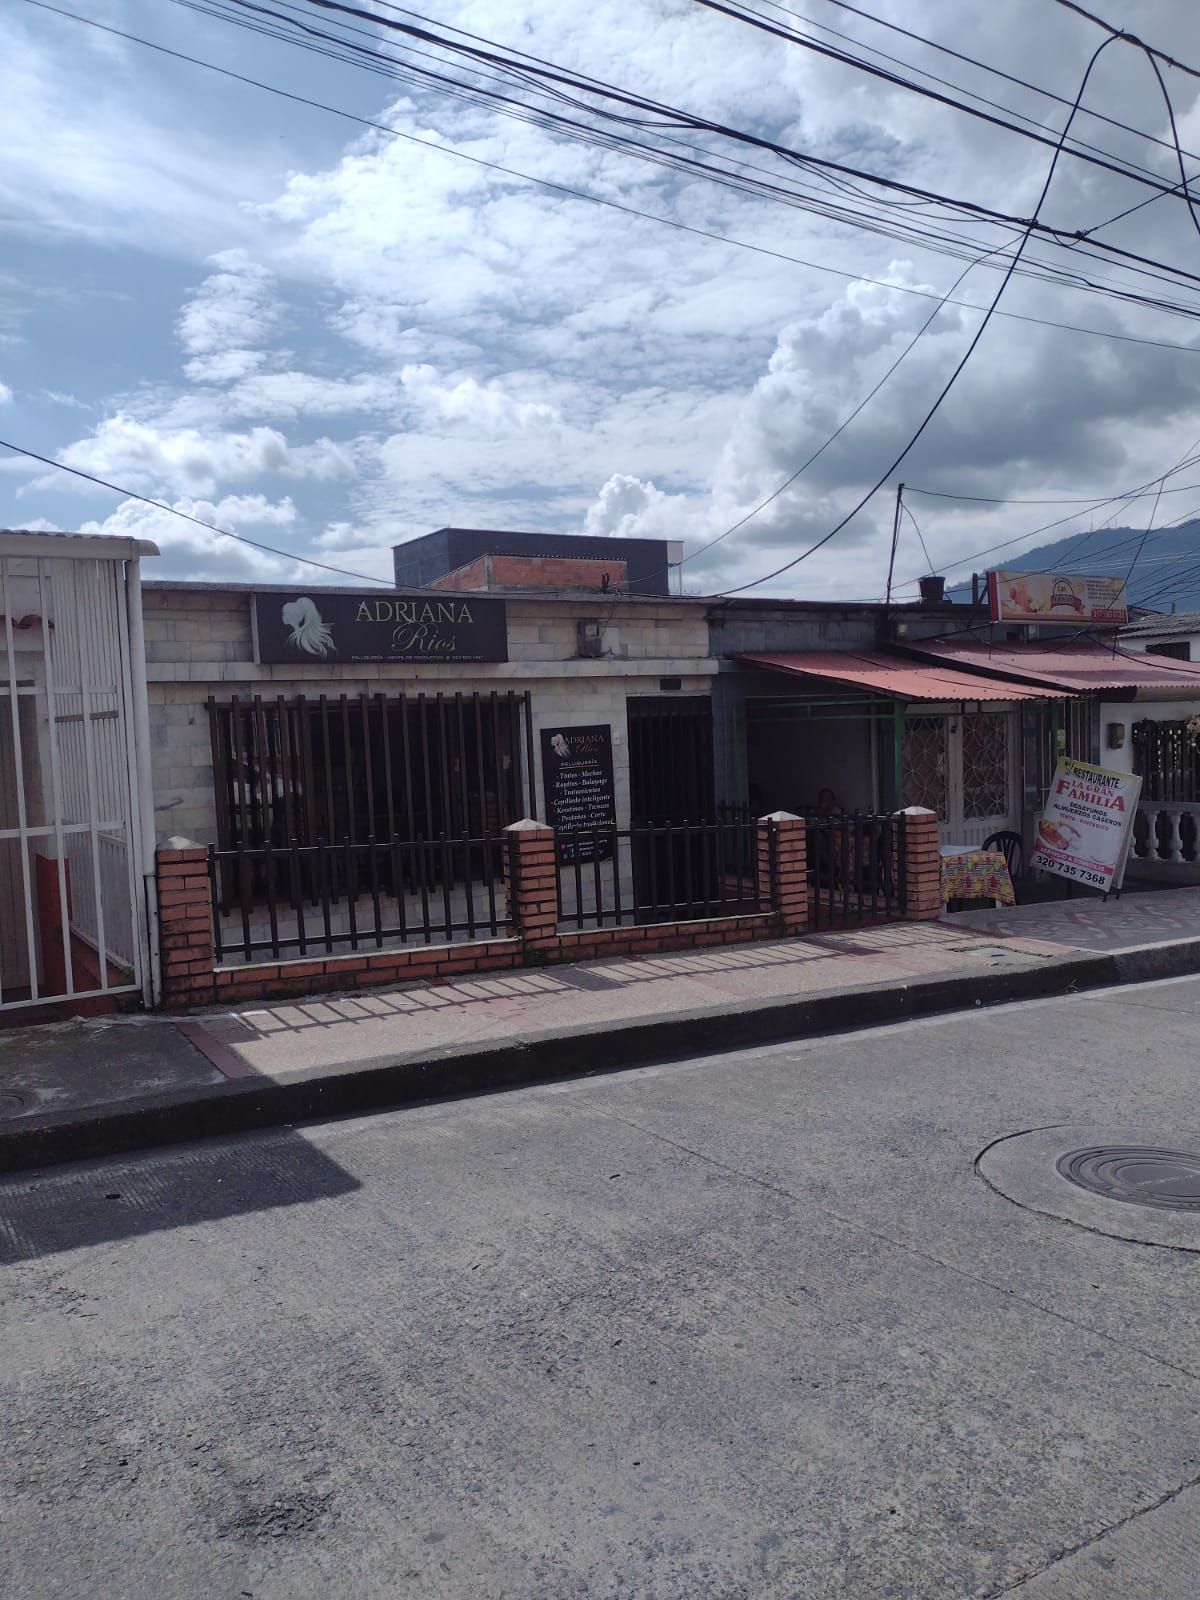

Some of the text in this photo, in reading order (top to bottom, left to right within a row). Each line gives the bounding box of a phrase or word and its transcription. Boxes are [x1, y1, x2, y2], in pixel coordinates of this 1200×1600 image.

[355, 601, 474, 623] ADRIANA
[565, 734, 605, 744] ADRIANA
[1072, 780, 1115, 797] LA GRAN
[1073, 767, 1121, 789] RESTAURANTE
[1055, 778, 1126, 812] FAMILIA
[1053, 803, 1123, 827] ALMUERZOS CASEROS
[1069, 801, 1109, 817] DESAYUNOS
[1036, 855, 1106, 885] 320 735 7368
